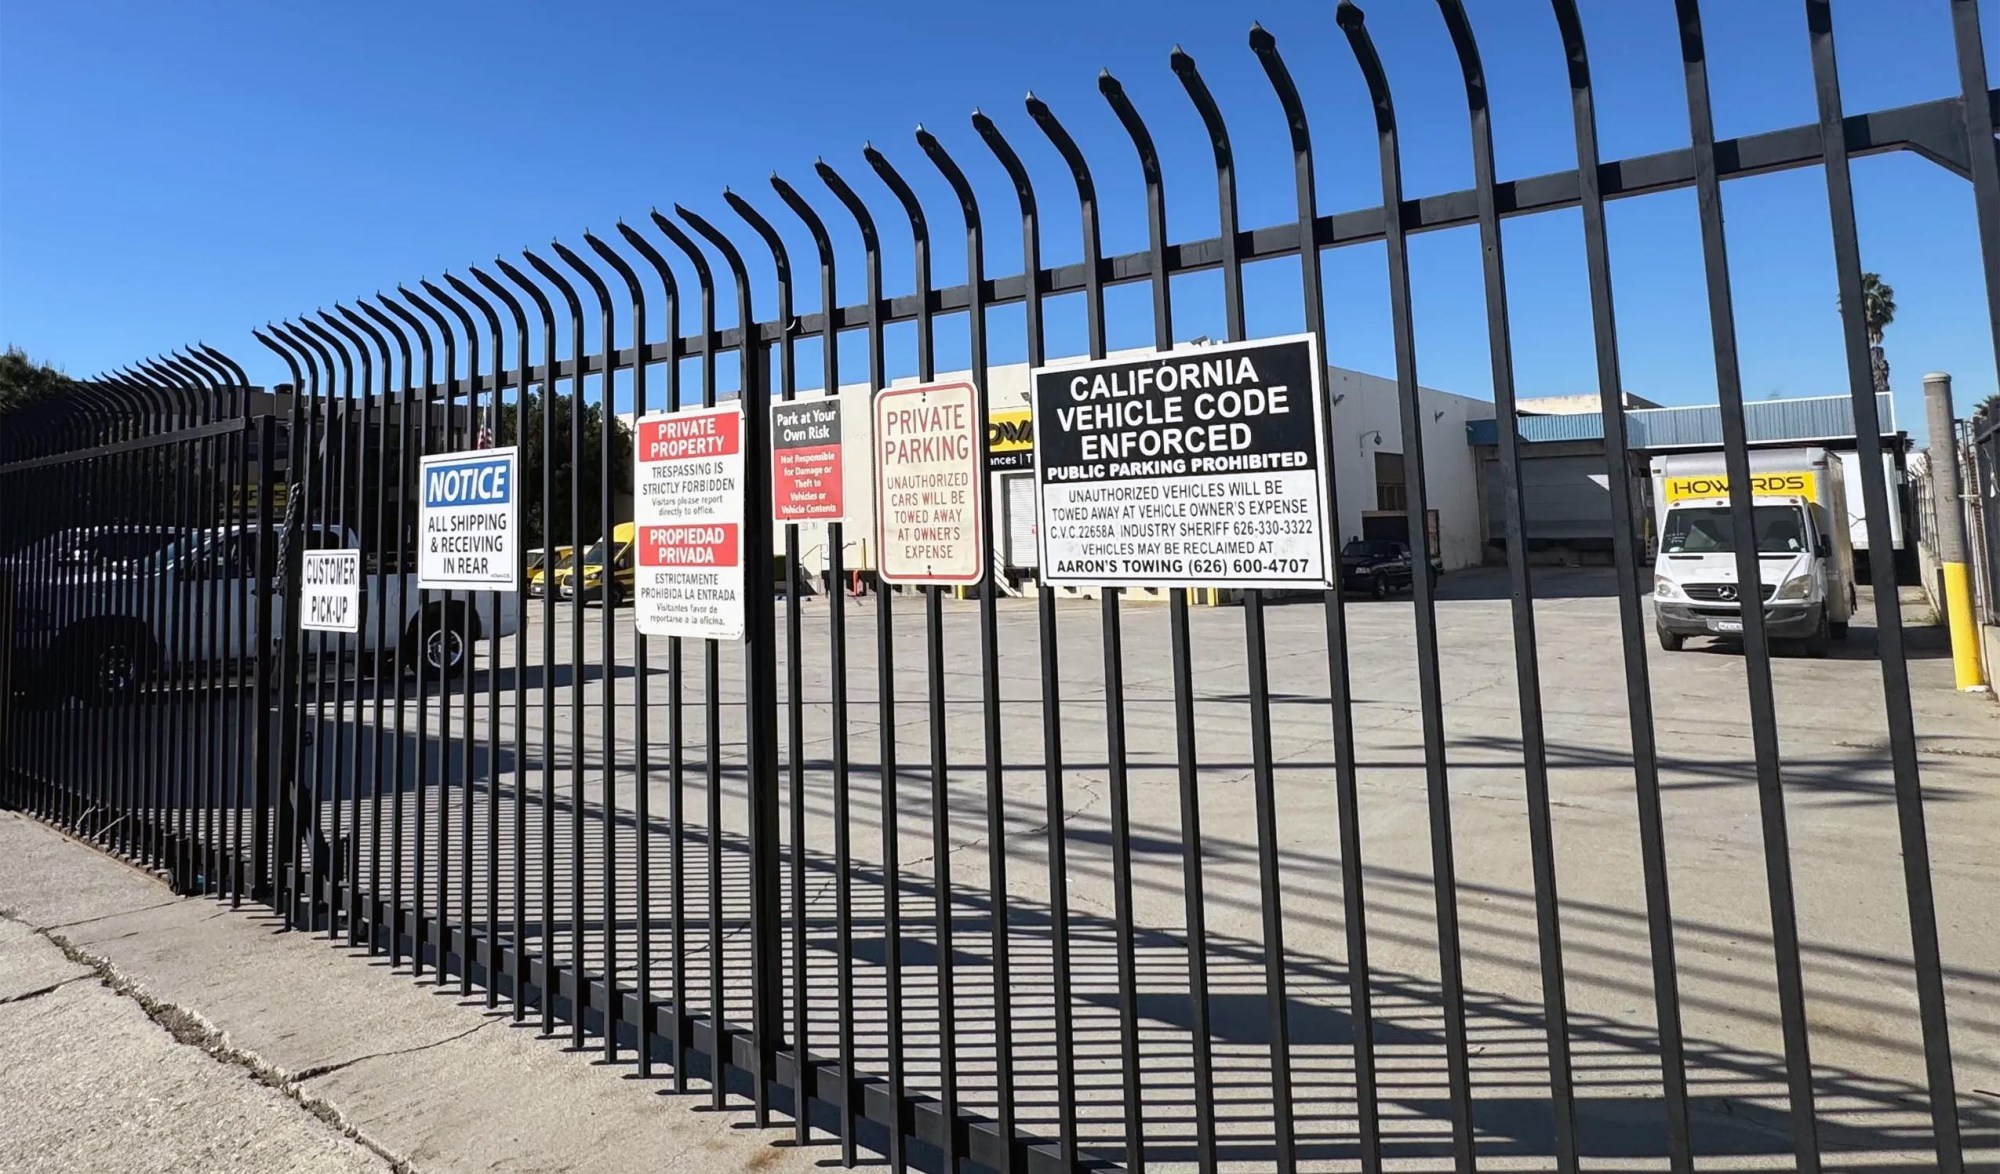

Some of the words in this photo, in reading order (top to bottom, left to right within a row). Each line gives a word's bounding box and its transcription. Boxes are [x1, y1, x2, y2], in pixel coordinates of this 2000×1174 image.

[1070, 357, 1259, 400] CALIFORNIA
[777, 412, 798, 426] Park
[801, 411, 811, 424] at
[813, 409, 836, 423] Your
[1057, 396, 1183, 432] VEHICLE
[1194, 386, 1289, 420] CODE
[658, 418, 715, 439] PRIVATE
[887, 404, 964, 436] PRIVATE
[784, 428, 806, 441] Own
[809, 426, 829, 439] Risk
[1081, 423, 1251, 460] ENFORCED
[650, 436, 724, 458] PROPERTY
[886, 434, 968, 465] PARKING
[781, 455, 793, 464] Not
[795, 452, 835, 463] Responsible
[1048, 465, 1104, 480] PUBLIC
[1110, 459, 1186, 477] PARKING
[1191, 452, 1308, 472] PROHIBITED
[652, 463, 711, 478] TRESPASSING
[714, 462, 723, 474] IS
[784, 468, 794, 476] for
[796, 467, 823, 476] Damage
[824, 466, 832, 474] or
[429, 466, 506, 502] NOTICE
[643, 481, 679, 495] STRICTLY
[682, 478, 734, 492] FORBIDDEN
[795, 480, 813, 488] Theft
[887, 472, 968, 489] UNAUTHORIZED
[1674, 476, 1803, 494] HOWRD'S
[791, 492, 817, 501] Vehicles
[892, 494, 918, 507] CARS
[922, 492, 947, 505] WILL
[952, 491, 965, 504] BE
[1069, 486, 1159, 502] UNAUTHORIZED
[1162, 483, 1224, 499] VEHICLES
[1229, 482, 1260, 496] WILL
[1264, 480, 1283, 494] BE
[652, 498, 675, 506] Visitors
[678, 497, 699, 506] please
[702, 495, 723, 505] report
[782, 505, 805, 514] Vehicle
[806, 504, 836, 513] Contents
[659, 507, 682, 516] directly
[684, 507, 692, 515] to
[694, 505, 715, 514] office.
[894, 510, 928, 524] TOWED
[934, 509, 962, 522] AWAY
[1052, 507, 1088, 521] TOWED
[1091, 506, 1119, 520] AWAY
[1123, 505, 1136, 518] AT
[1138, 503, 1186, 518] VEHICLE
[1190, 501, 1245, 516] OWNER'S
[1250, 499, 1308, 514] EXPENSE
[428, 516, 447, 532] ALL
[450, 513, 506, 531] SHIPPING
[1120, 523, 1176, 538] INDUSTRY
[1180, 521, 1229, 536] SHERIFF
[1234, 519, 1312, 535] 626-330-3322
[650, 528, 724, 545] PROPIEDAD
[898, 528, 909, 541] AT
[914, 527, 960, 541] OWNER'S
[431, 538, 438, 552] &
[441, 535, 503, 552] RECEIVING
[906, 545, 953, 559] EXPENSE
[1082, 544, 1134, 555] VEHICLES
[1138, 543, 1160, 554] MAY
[1164, 542, 1180, 554] BE
[1184, 542, 1255, 554] RECLAIMED
[1258, 541, 1273, 554] AT
[658, 548, 714, 563] PRIVADA
[306, 557, 355, 585] CUSTOMER
[444, 558, 454, 574] IN
[458, 558, 488, 574] REAR
[1057, 560, 1117, 572] AARON'S
[1122, 560, 1182, 572] TOWING
[1188, 559, 1228, 576] (626)
[1233, 559, 1310, 572] 600-4707
[655, 573, 719, 584] ESTRICTAMENTE
[642, 588, 682, 599] PROHIBIDA
[685, 588, 695, 600] LA
[698, 589, 735, 601] ENTRADA
[311, 596, 347, 623] PICK-UP
[657, 603, 688, 612] Visitantes
[690, 605, 707, 613] favor
[710, 605, 718, 613] de
